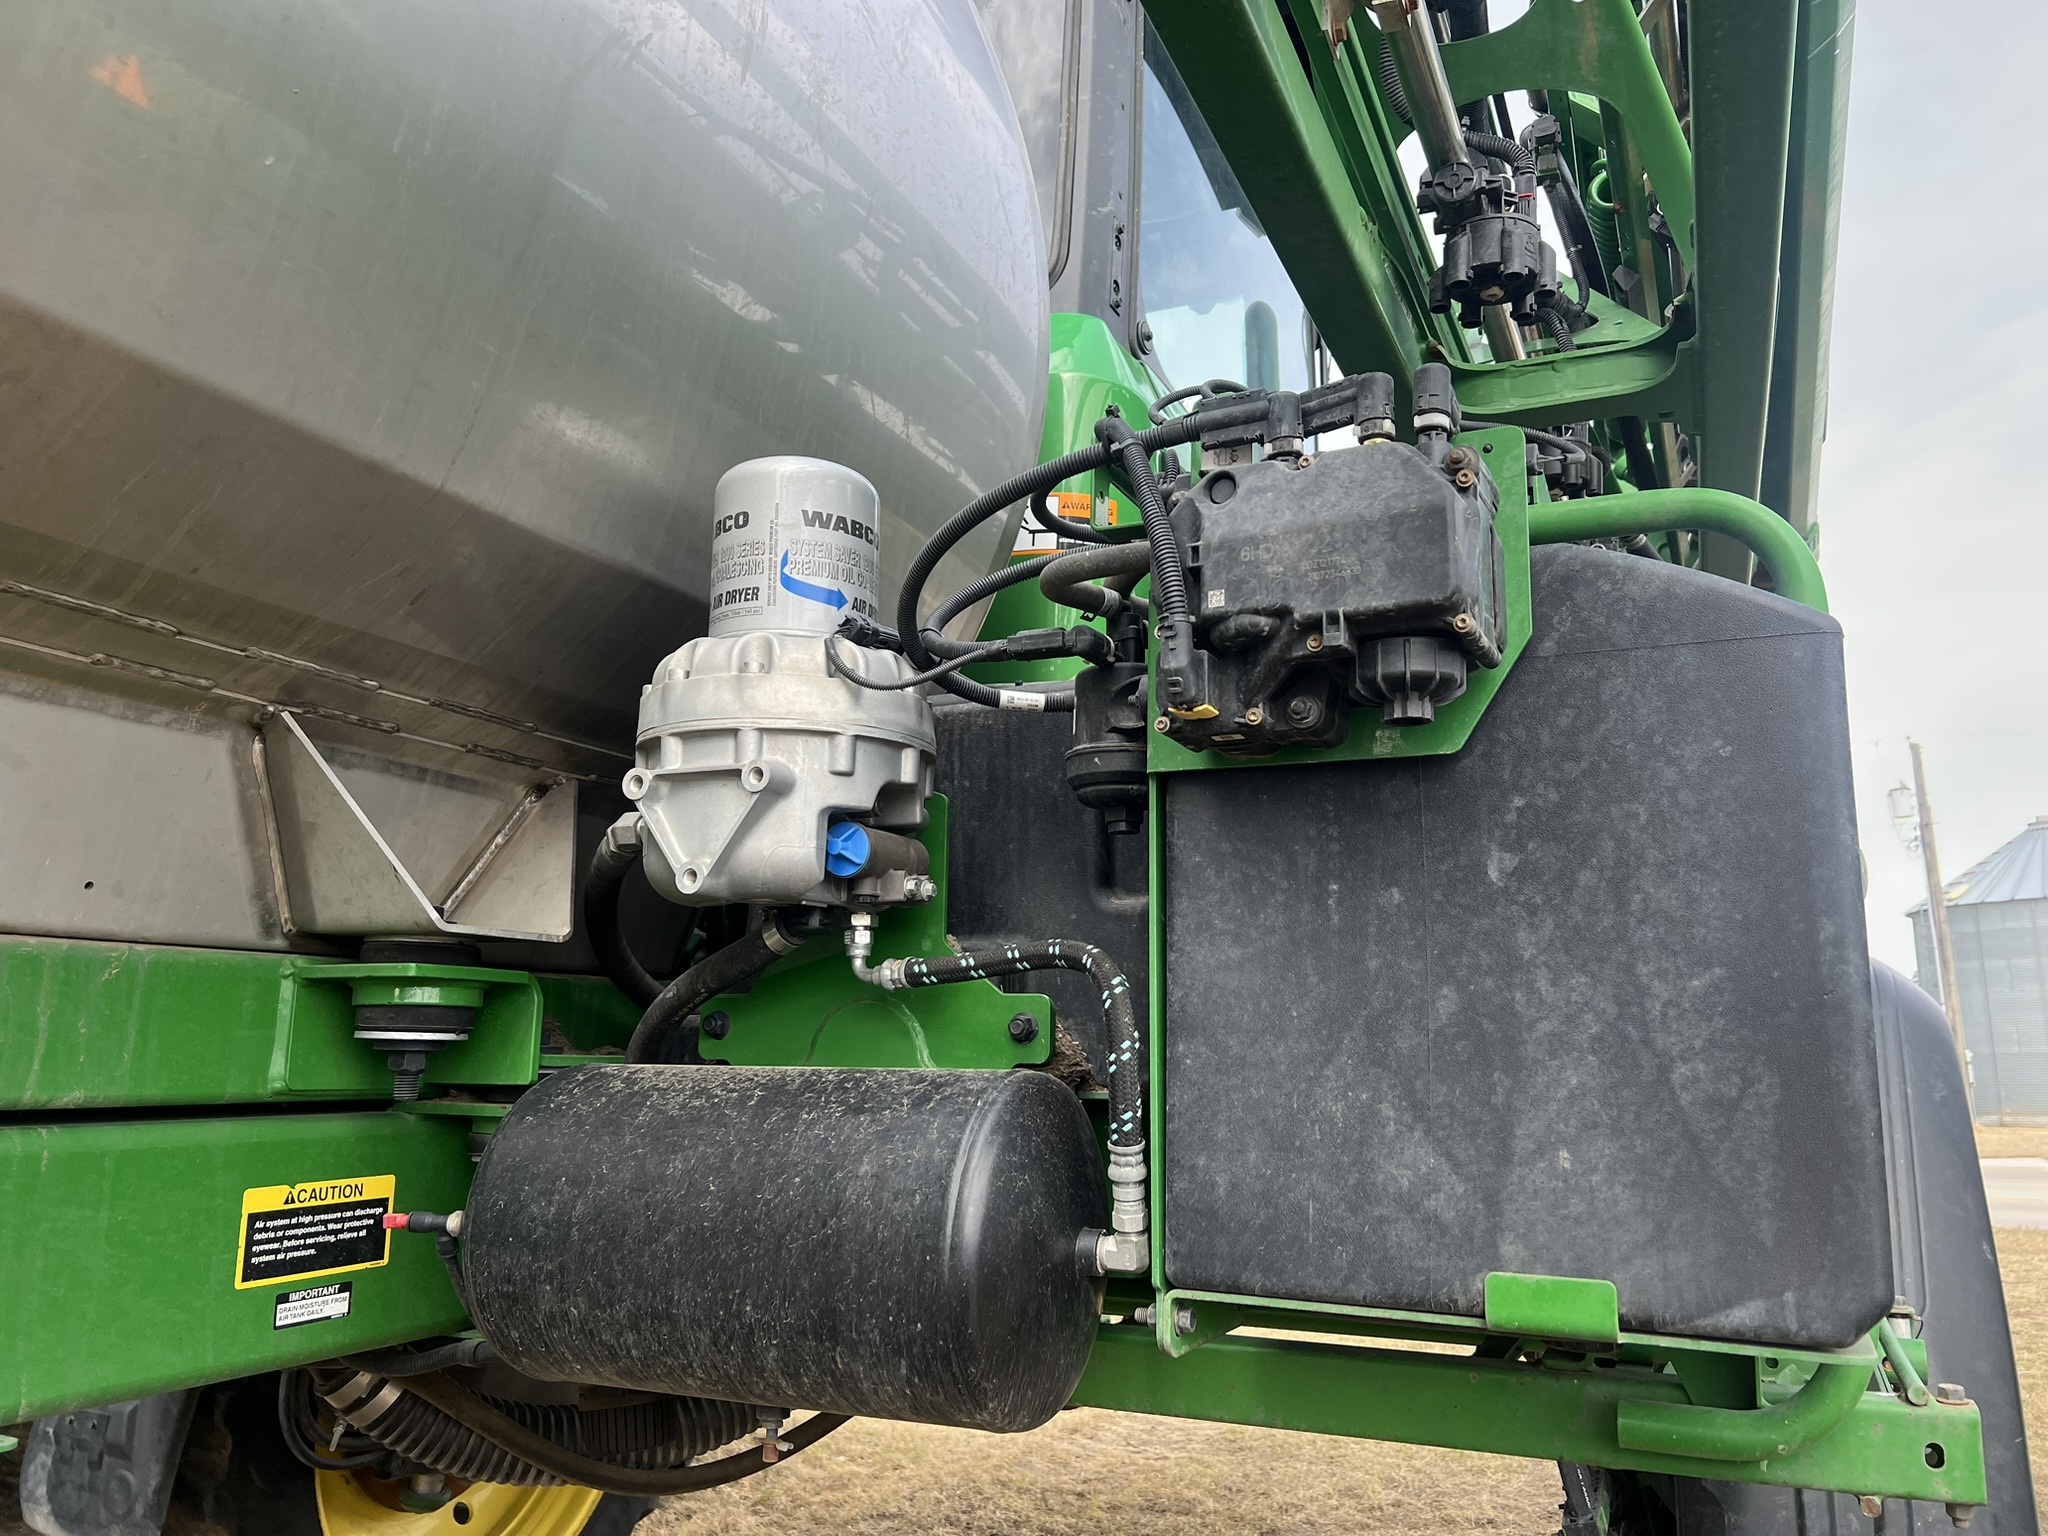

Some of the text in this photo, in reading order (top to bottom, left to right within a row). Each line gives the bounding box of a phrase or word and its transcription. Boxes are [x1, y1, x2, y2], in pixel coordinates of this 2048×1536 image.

[714, 511, 750, 540] BCO
[736, 539, 766, 559] SERIES
[790, 539, 833, 560] SYSTEM
[835, 544, 861, 568] SAVER
[1240, 543, 1275, 562] 6HD
[789, 557, 839, 581] PREMIUM
[842, 565, 855, 585] OIL
[724, 586, 760, 606] DRYER
[851, 596, 868, 616] AIR
[297, 1183, 364, 1204] CAUTION
[254, 1207, 383, 1229] Air system at high pressure can discharge
[253, 1230, 275, 1240] debris
[285, 1224, 326, 1236] components.
[327, 1222, 344, 1231] Wear
[343, 1218, 374, 1230] protective
[282, 1238, 305, 1247] Before
[305, 1234, 336, 1244] servicing,
[337, 1231, 358, 1240] relieve
[359, 1229, 367, 1237] all
[251, 1248, 317, 1264] system air pressure.
[289, 1284, 340, 1302] IMPORTANT
[278, 1295, 348, 1314] DRAIN MOISTURE FROM
[278, 1314, 289, 1322] AIR
[290, 1311, 305, 1320] TANK
[307, 1308, 324, 1317] DAILY
